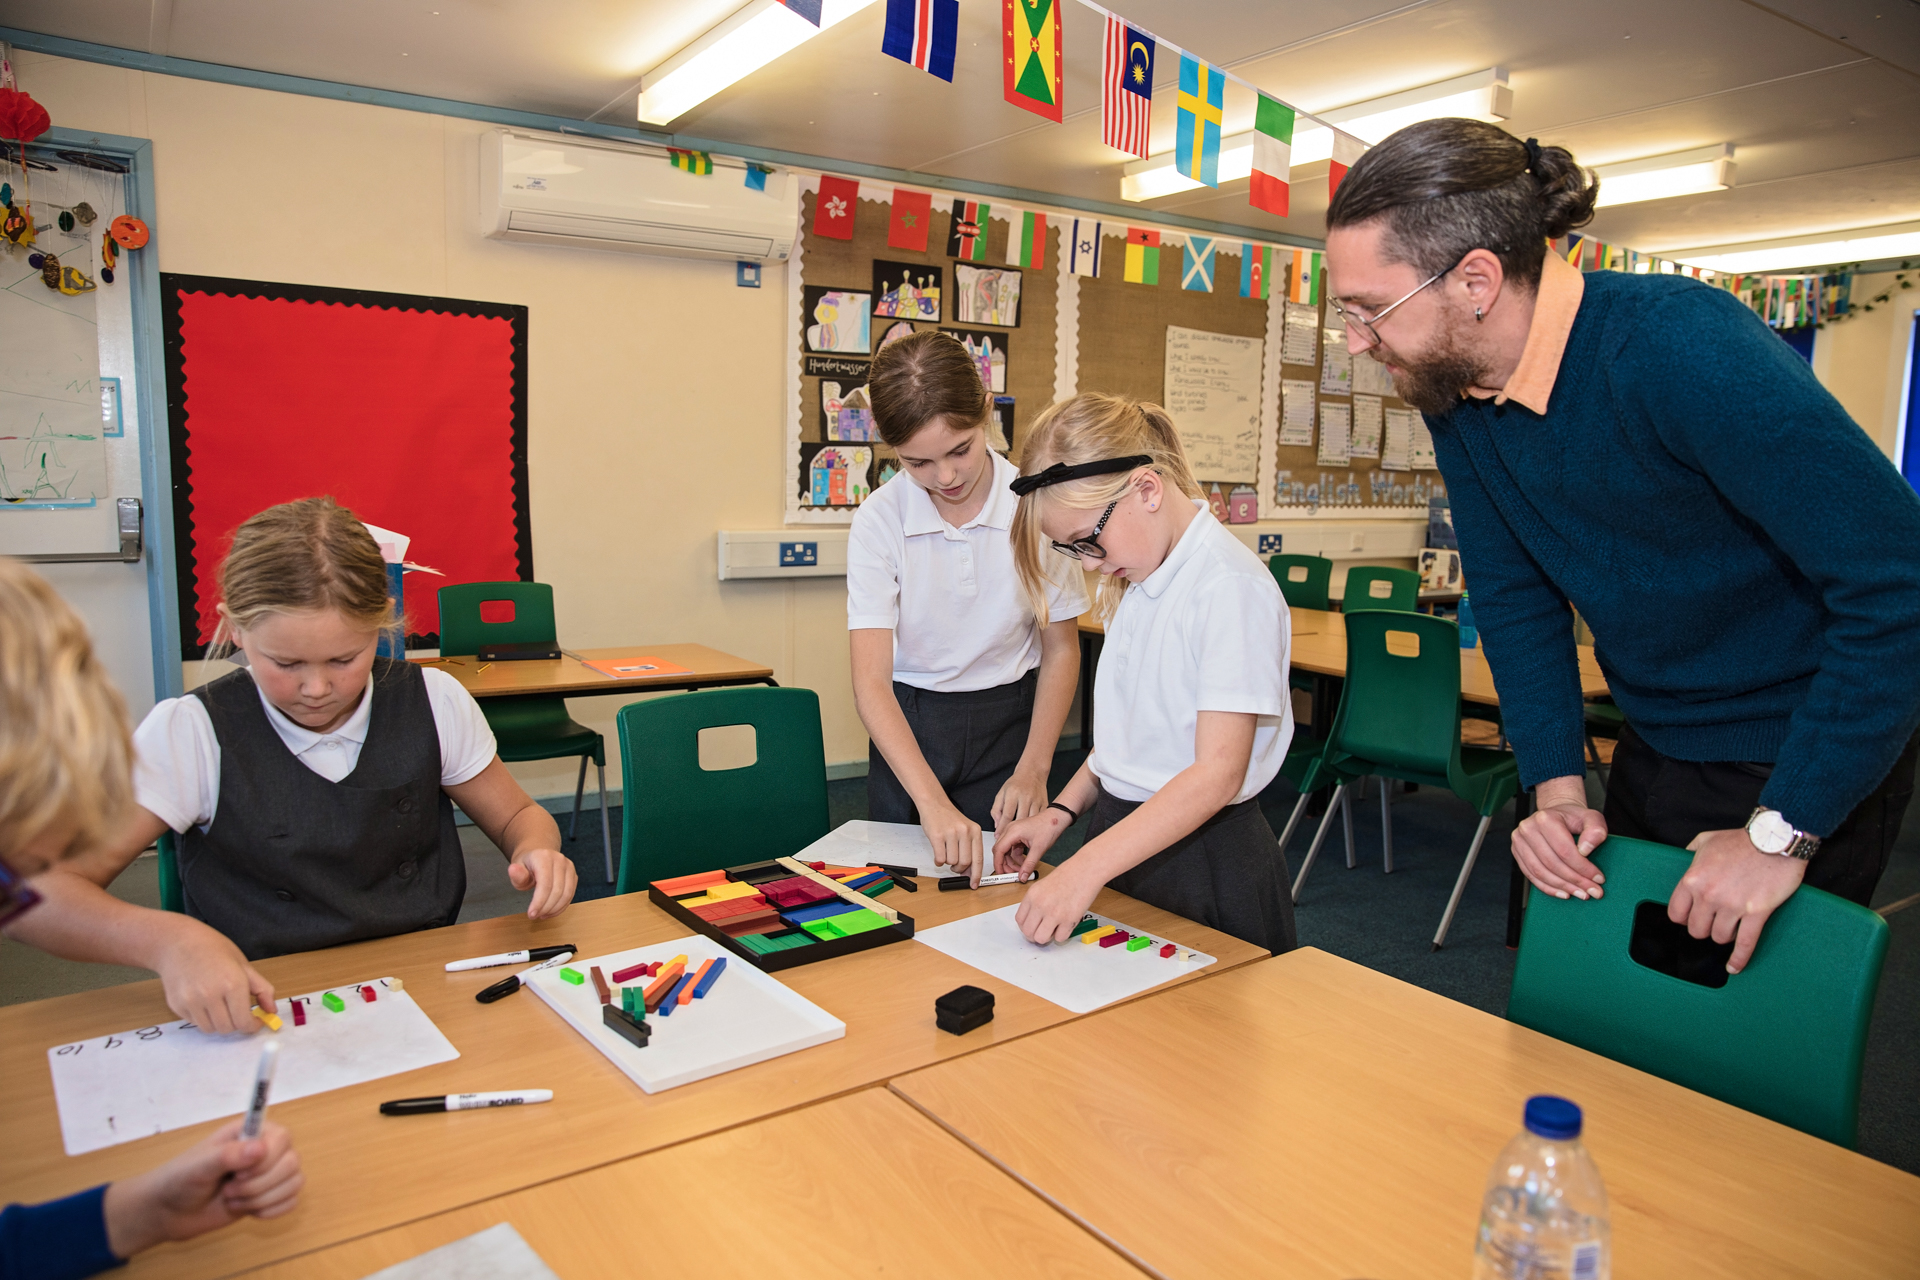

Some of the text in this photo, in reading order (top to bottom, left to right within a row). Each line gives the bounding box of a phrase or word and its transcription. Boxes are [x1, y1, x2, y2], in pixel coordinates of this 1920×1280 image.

[1276, 470, 1446, 515] English Workin
[135, 1026, 163, 1040] 8
